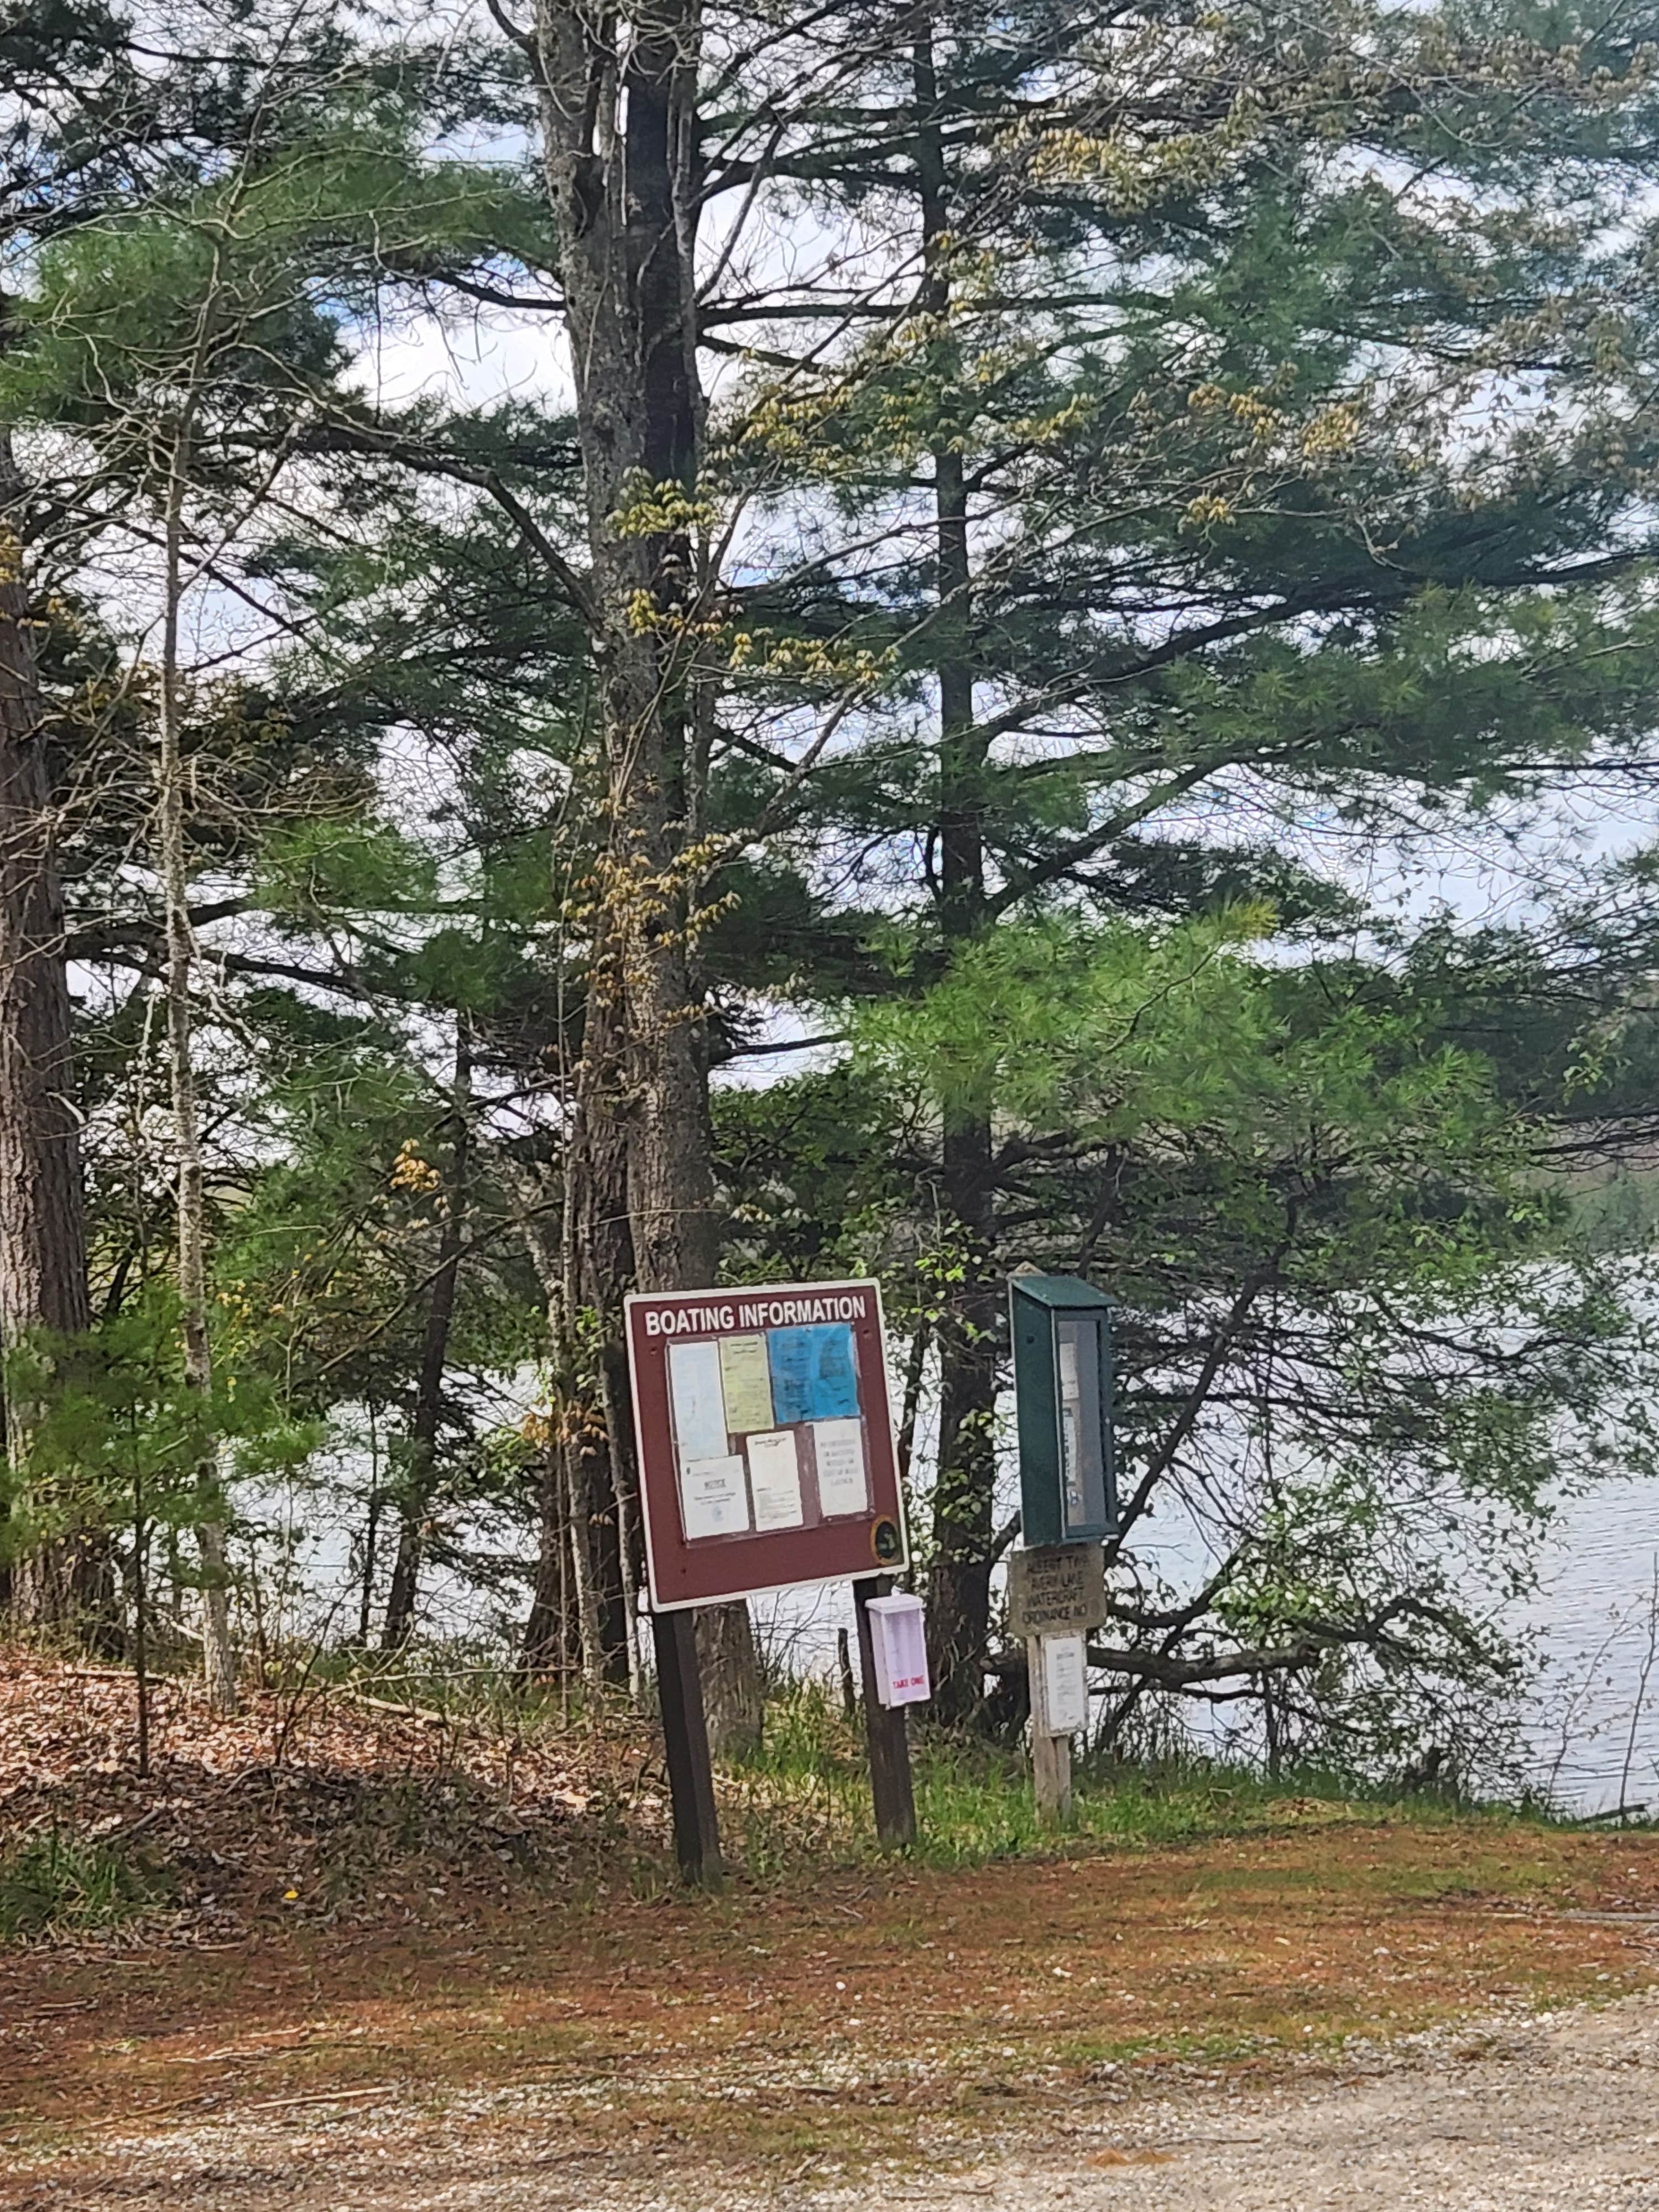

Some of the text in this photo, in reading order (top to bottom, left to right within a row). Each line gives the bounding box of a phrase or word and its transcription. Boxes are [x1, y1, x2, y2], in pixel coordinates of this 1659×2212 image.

[645, 1296, 866, 1336] BOATING INFORMATION
[893, 1679, 909, 1689] TAKE
